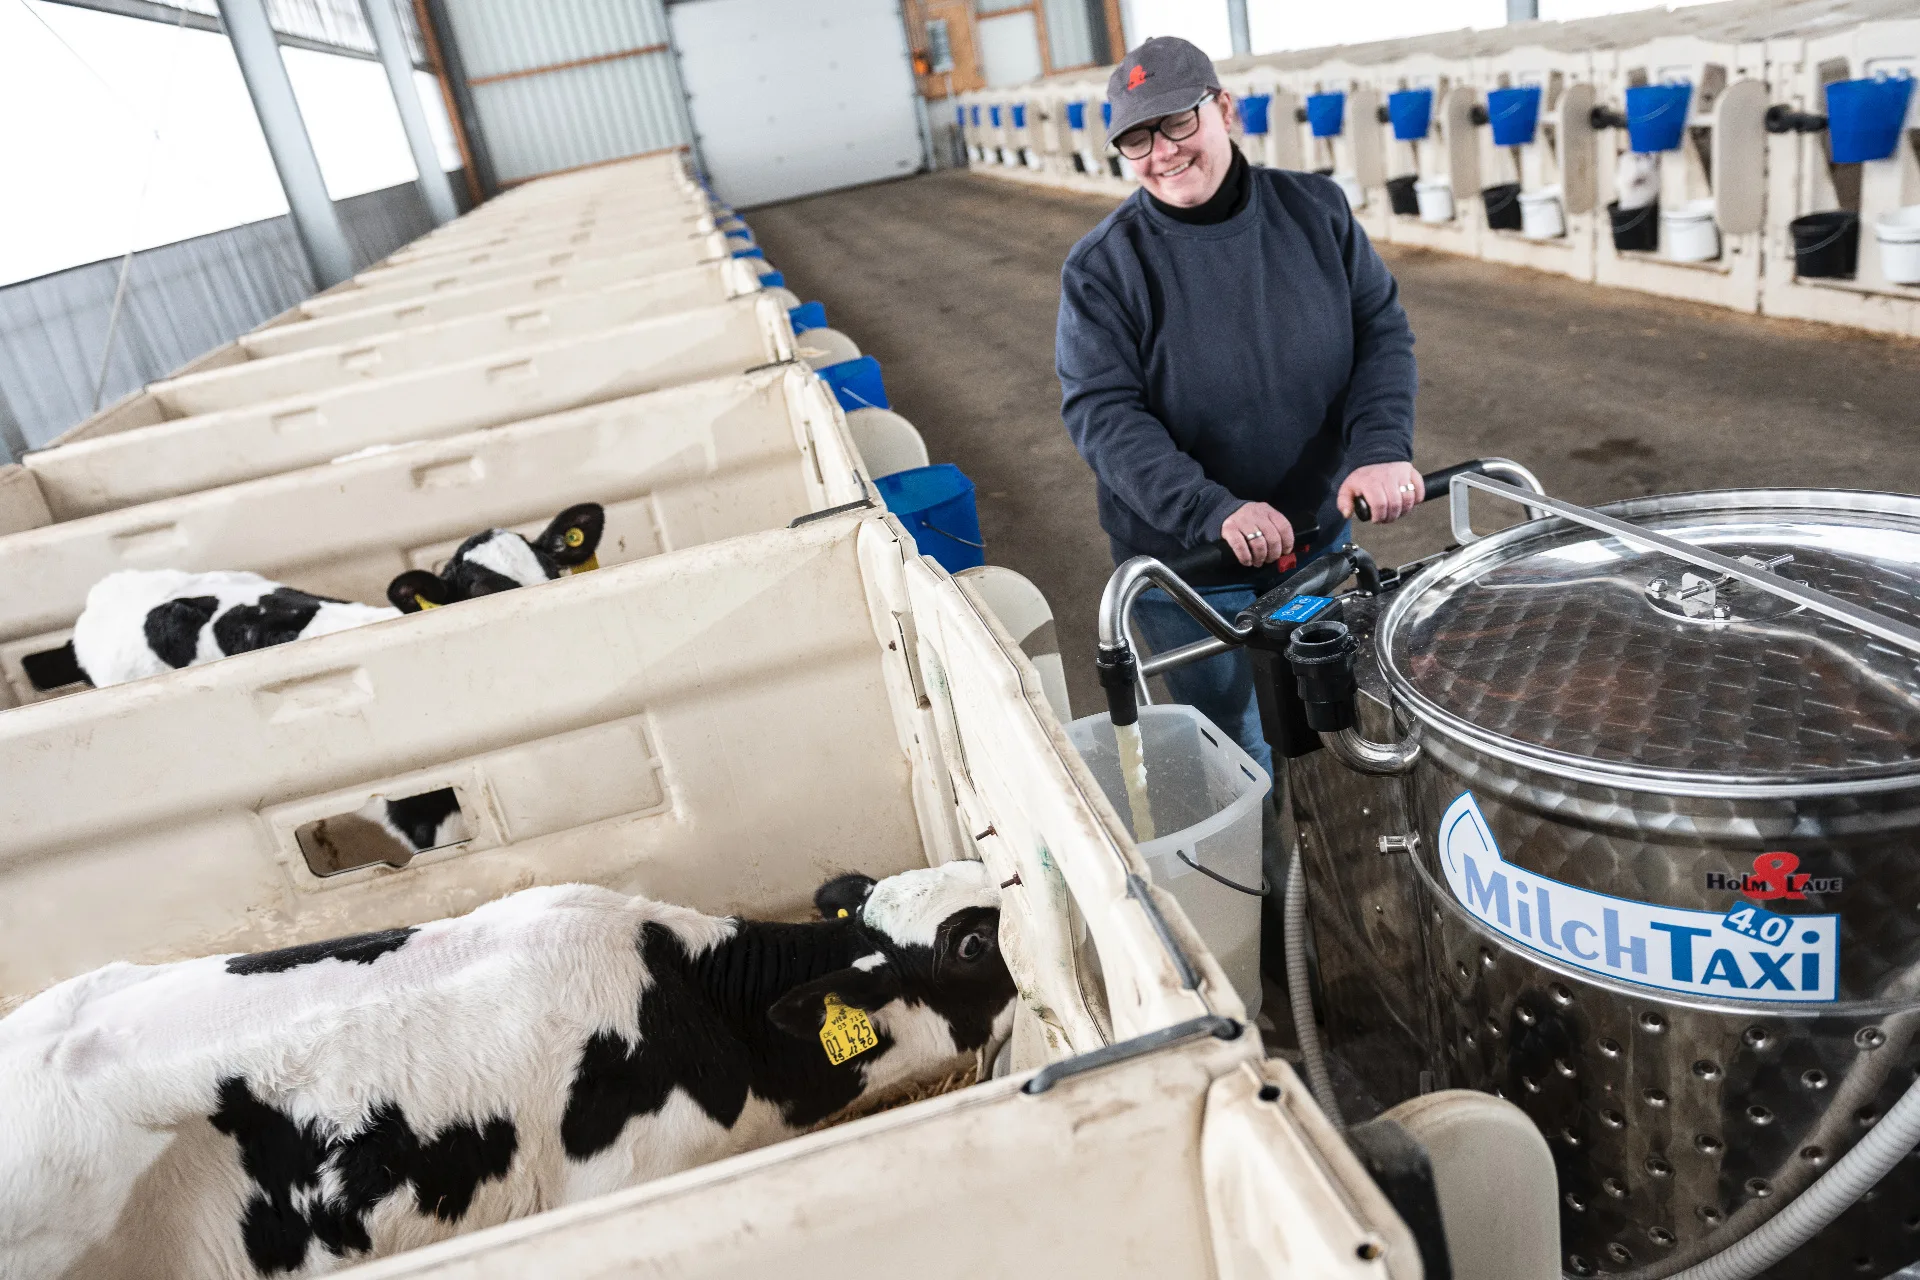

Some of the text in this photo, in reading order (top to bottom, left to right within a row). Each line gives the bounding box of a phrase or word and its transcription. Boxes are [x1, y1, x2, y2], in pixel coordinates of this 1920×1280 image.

[1727, 907, 1787, 942] 4.0
[850, 1012, 863, 1023] 715
[825, 1019, 871, 1056] 01 425
